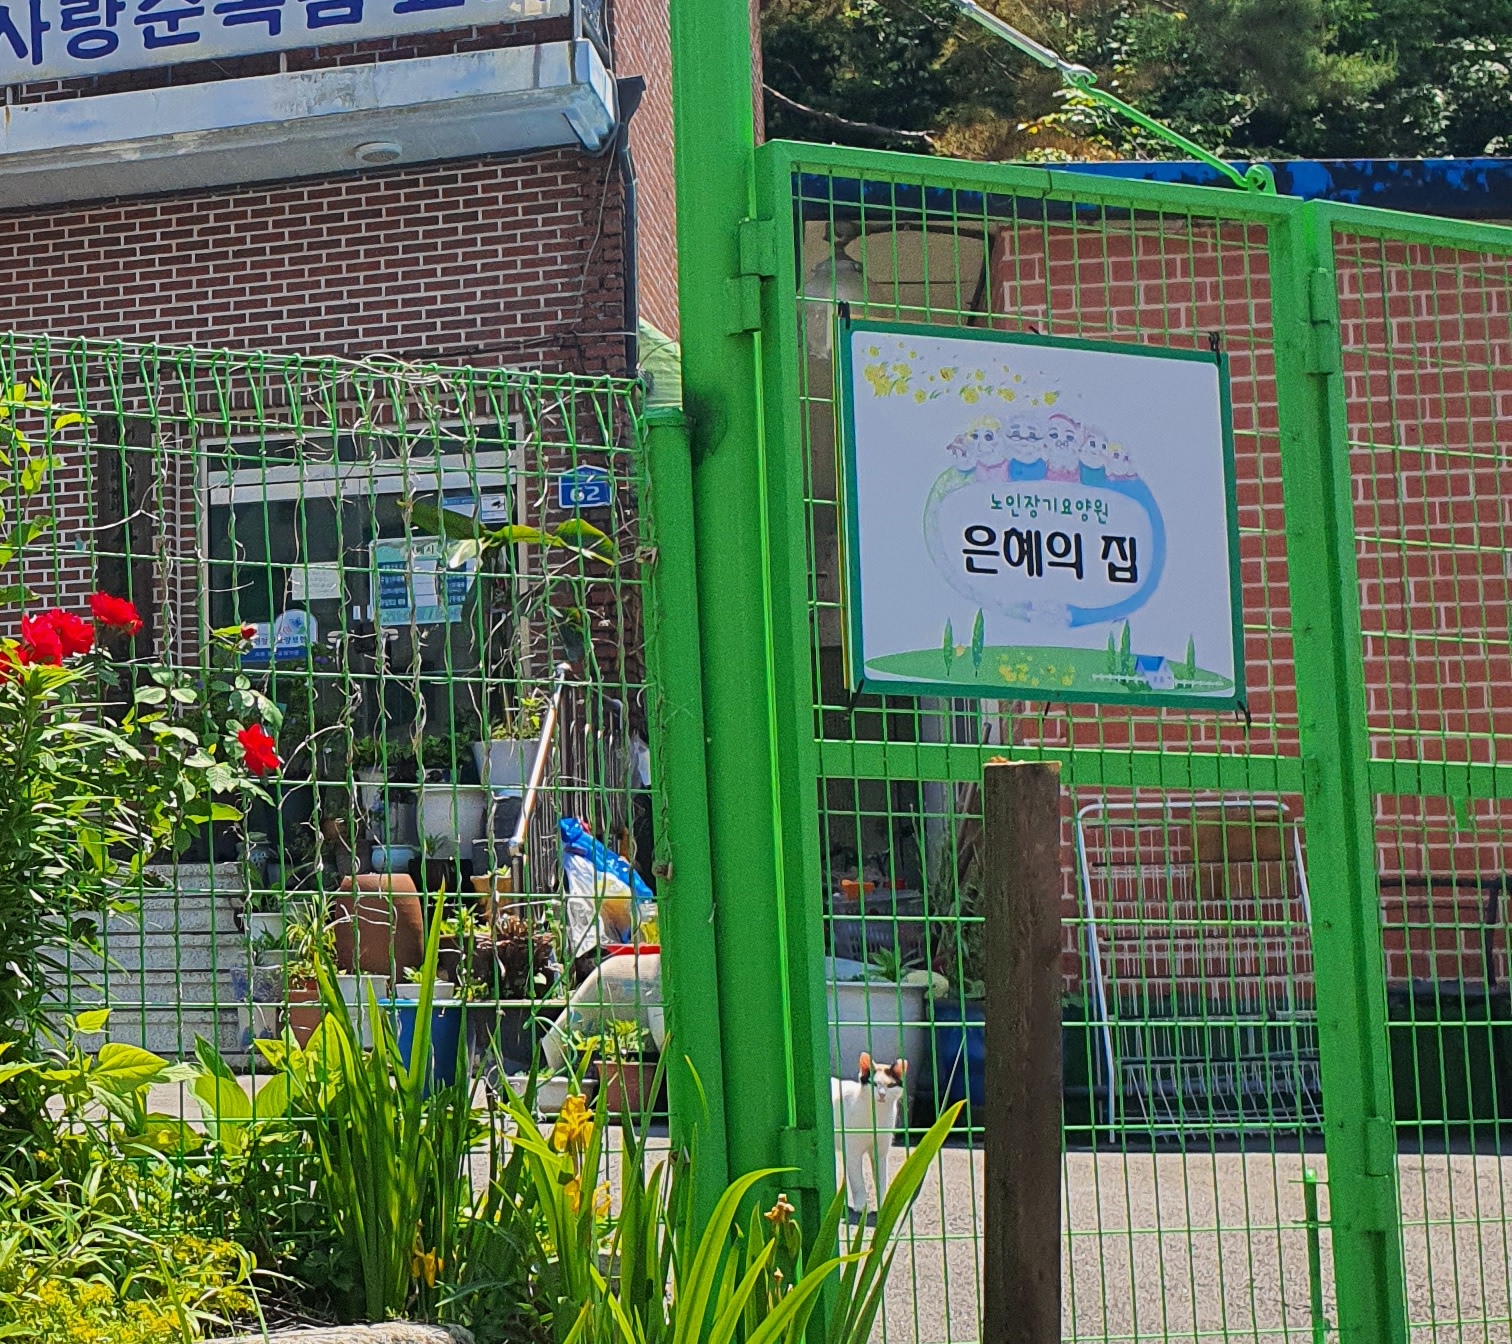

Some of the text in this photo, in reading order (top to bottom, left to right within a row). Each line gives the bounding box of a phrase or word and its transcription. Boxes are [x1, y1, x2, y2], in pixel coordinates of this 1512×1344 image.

[570, 485, 601, 502] 62
[990, 492, 1109, 525] 노인장기요양원
[962, 525, 1139, 584] 은혜의 집
